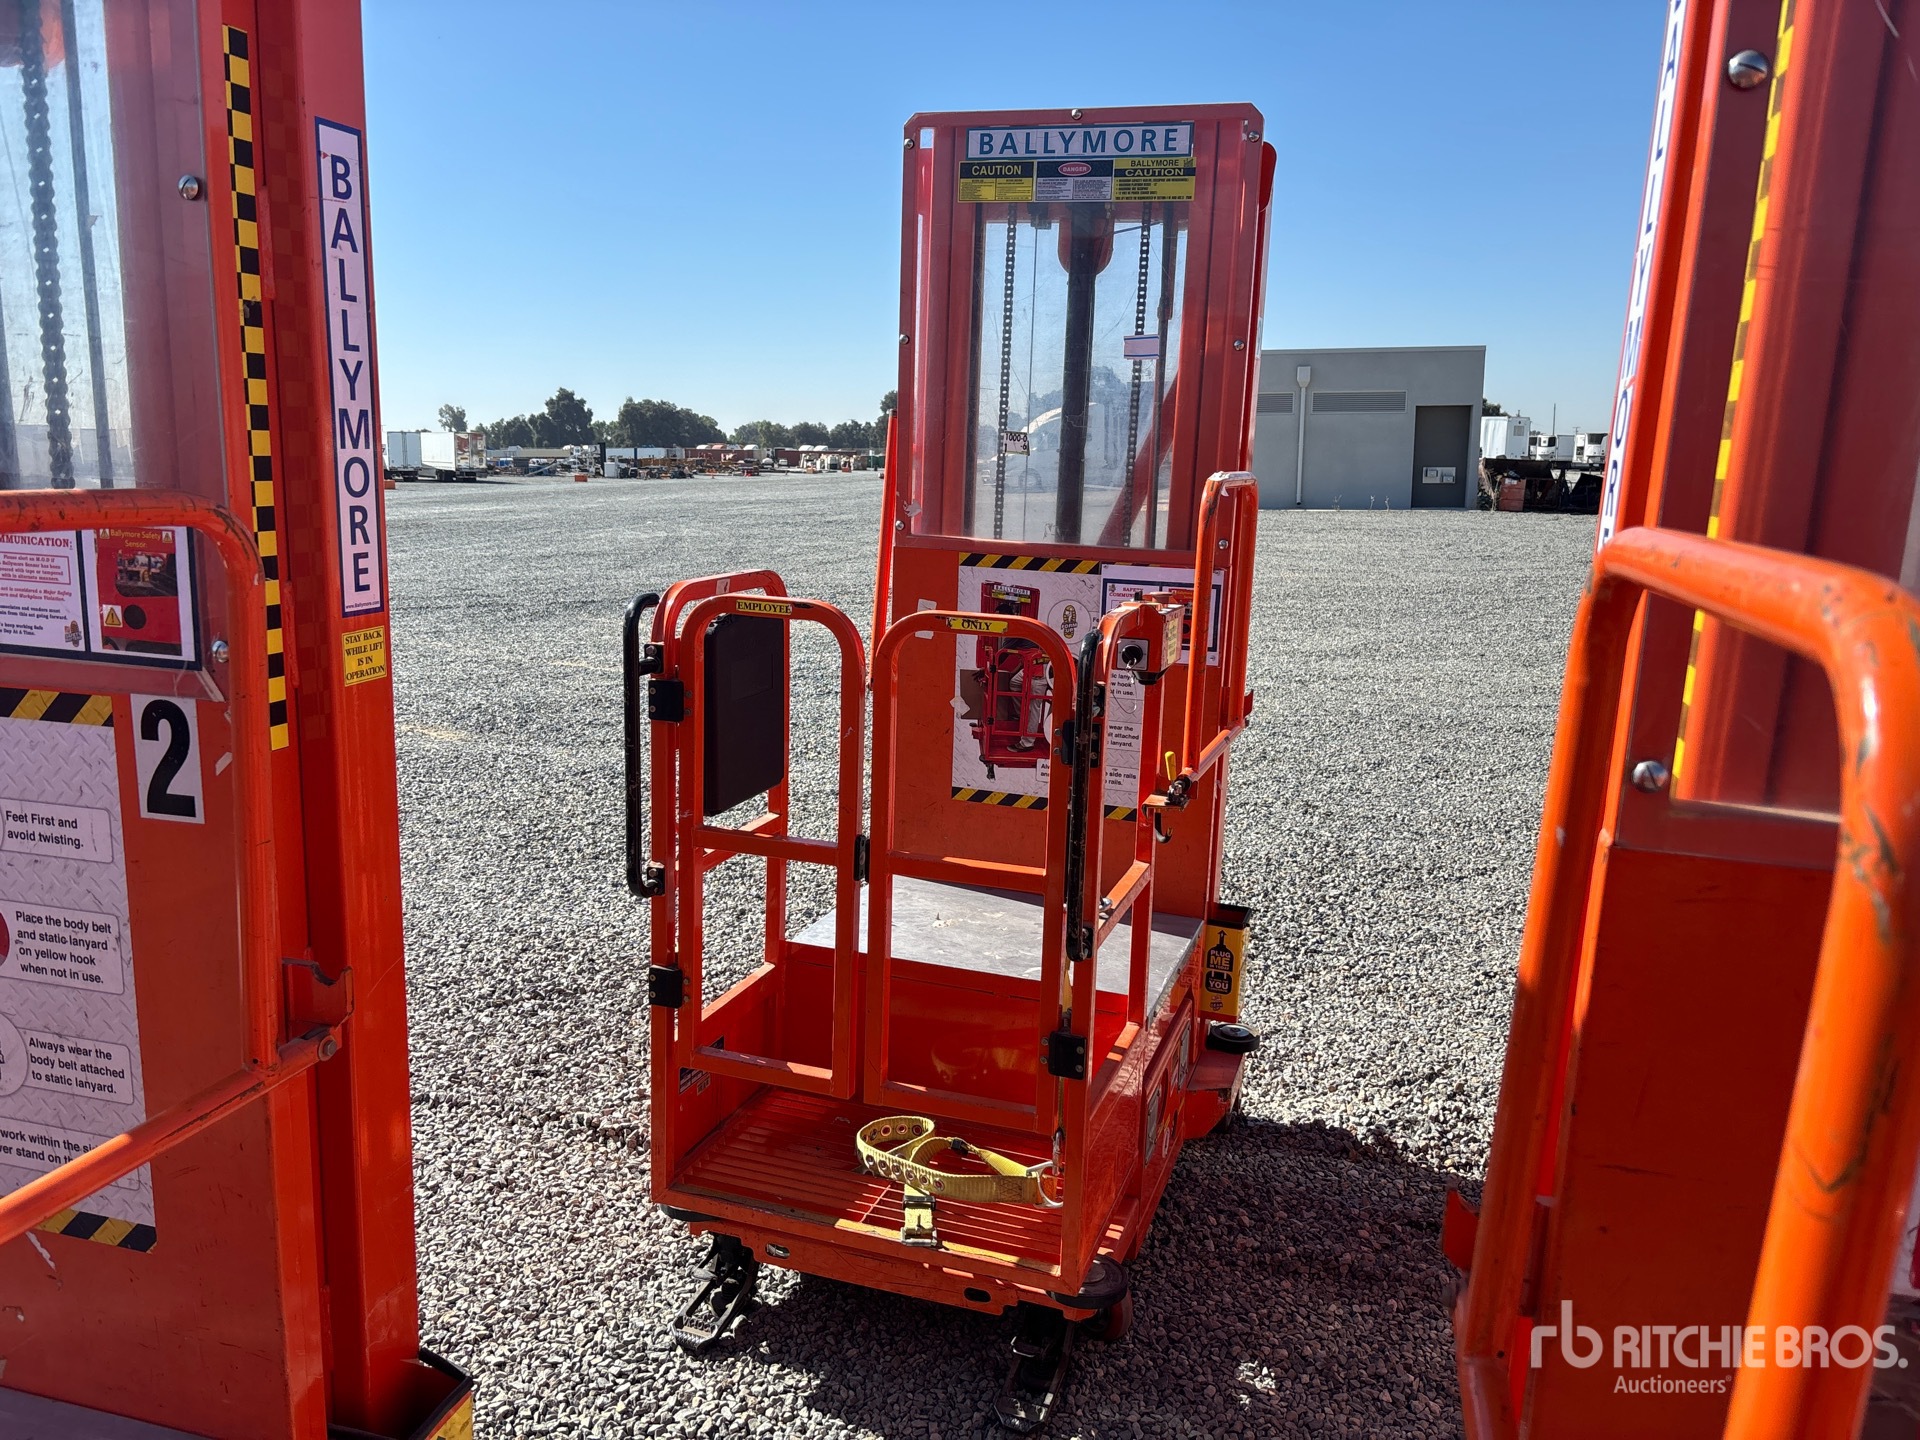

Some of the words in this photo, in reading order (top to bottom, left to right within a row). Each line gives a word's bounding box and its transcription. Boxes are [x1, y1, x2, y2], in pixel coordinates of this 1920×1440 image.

[979, 128, 1179, 155] BALLYMORE
[971, 165, 1022, 175] CAUTION
[1130, 159, 1180, 167] BALLYMORE
[1125, 168, 1184, 176] CAUTION
[331, 153, 371, 592] BALLYMORE
[110, 528, 141, 539] Ballymore
[141, 531, 161, 541] Safety
[738, 602, 791, 614] EMPLOYEE
[961, 621, 992, 631] ONLY
[345, 635, 361, 645] STAY
[363, 630, 383, 640] BACK
[345, 645, 368, 657] WHILE
[369, 641, 384, 652] LIFT
[357, 657, 364, 667] IS
[365, 655, 374, 665] IN
[346, 664, 386, 681] OPERATION
[1110, 740, 1133, 748] lanyard.
[140, 699, 198, 819] 2
[6, 810, 28, 824] Feet
[31, 813, 55, 827] First
[58, 817, 78, 829] and
[7, 829, 36, 842] avoid
[38, 831, 84, 850] twisting.
[16, 911, 43, 925] Place
[45, 915, 62, 927] the
[64, 918, 89, 933] body
[92, 921, 112, 934] belt
[17, 929, 36, 941] and
[39, 931, 67, 945] static
[69, 935, 109, 951] lanyard
[19, 946, 32, 957] on
[34, 949, 67, 962] yellow
[70, 953, 96, 966] hook
[1210, 949, 1231, 959] PLUG
[1210, 956, 1230, 968] ME
[20, 962, 47, 976] when
[50, 967, 67, 979] not
[70, 970, 79, 981] in
[82, 972, 104, 984] use.
[1209, 980, 1229, 991] YOU
[29, 1037, 65, 1053] Always
[68, 1043, 92, 1056] wear
[95, 1048, 112, 1061] the
[30, 1053, 55, 1069] body
[58, 1058, 78, 1071] belt
[80, 1063, 125, 1080] attached
[32, 1070, 42, 1081] to
[45, 1072, 72, 1086] static
[75, 1078, 117, 1095] lanyard.
[0, 1129, 26, 1142] work
[28, 1133, 60, 1149] within
[63, 1139, 80, 1152] the
[16, 1147, 45, 1162] stand
[48, 1153, 61, 1165] on
